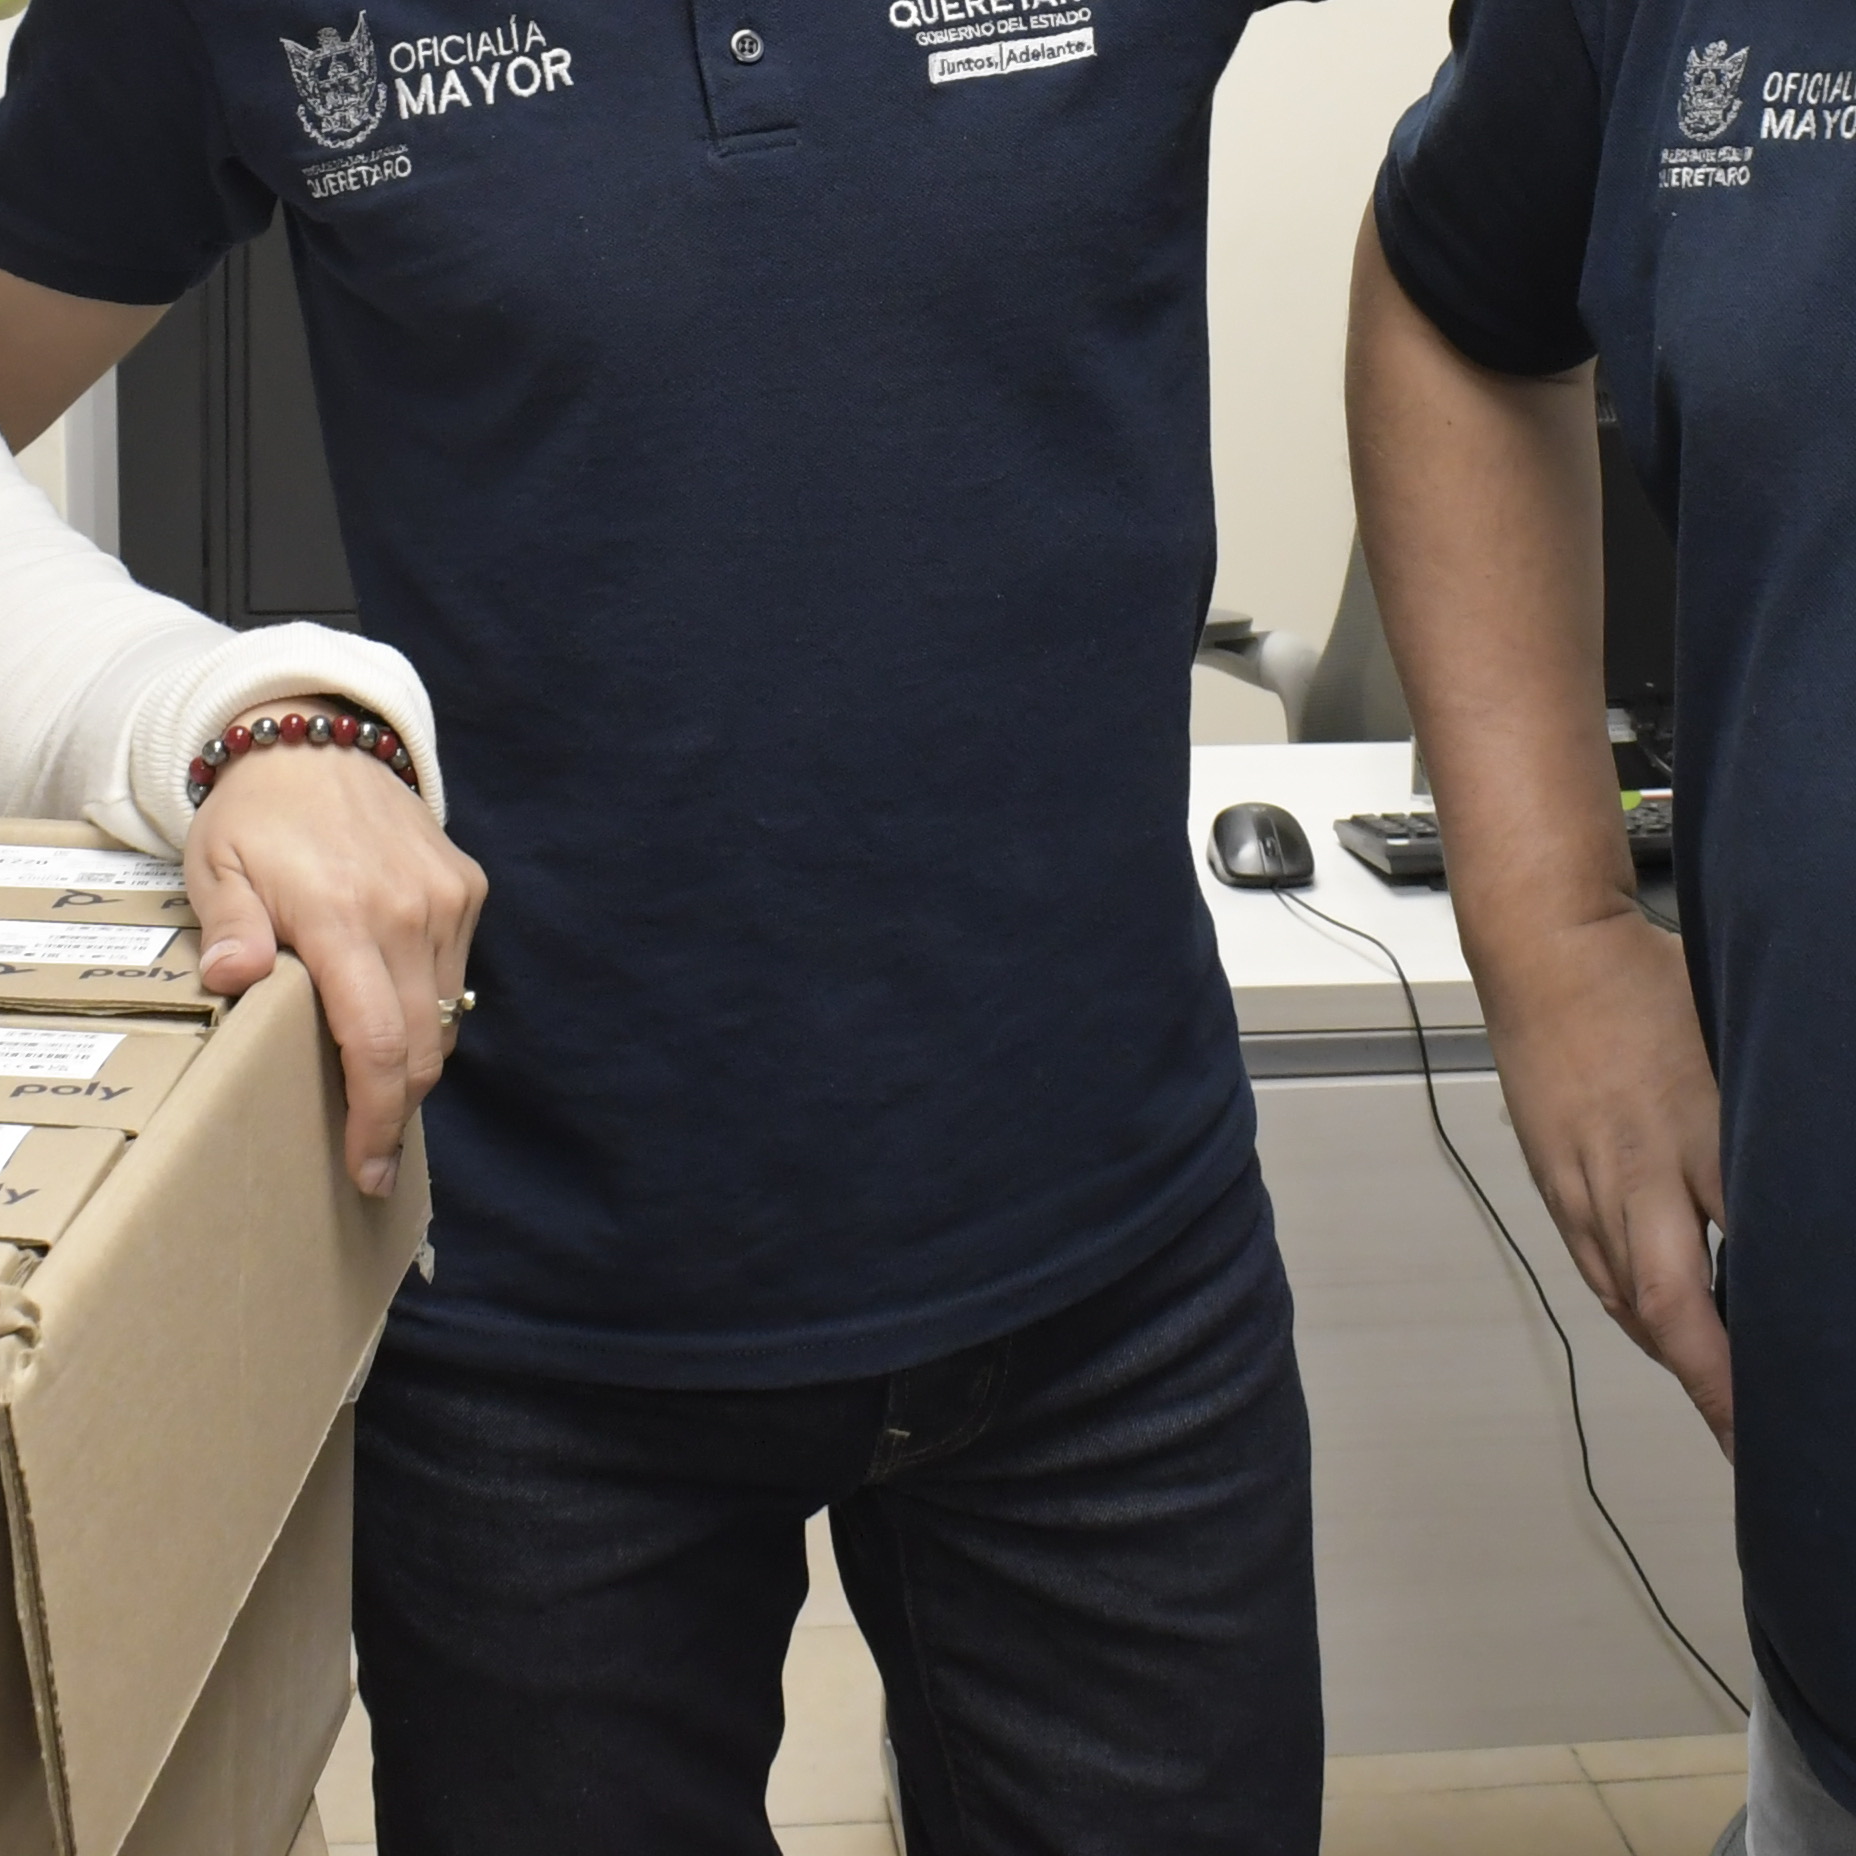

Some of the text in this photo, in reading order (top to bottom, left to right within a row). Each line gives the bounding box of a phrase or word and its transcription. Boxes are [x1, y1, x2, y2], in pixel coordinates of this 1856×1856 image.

[390, 13, 547, 74] OFICIALÍA
[916, 7, 1092, 46] GOBIERNO DEL ESTADO
[394, 48, 575, 120] MAYOR
[78, 964, 193, 983] poly
[9, 1079, 135, 1102] poly
